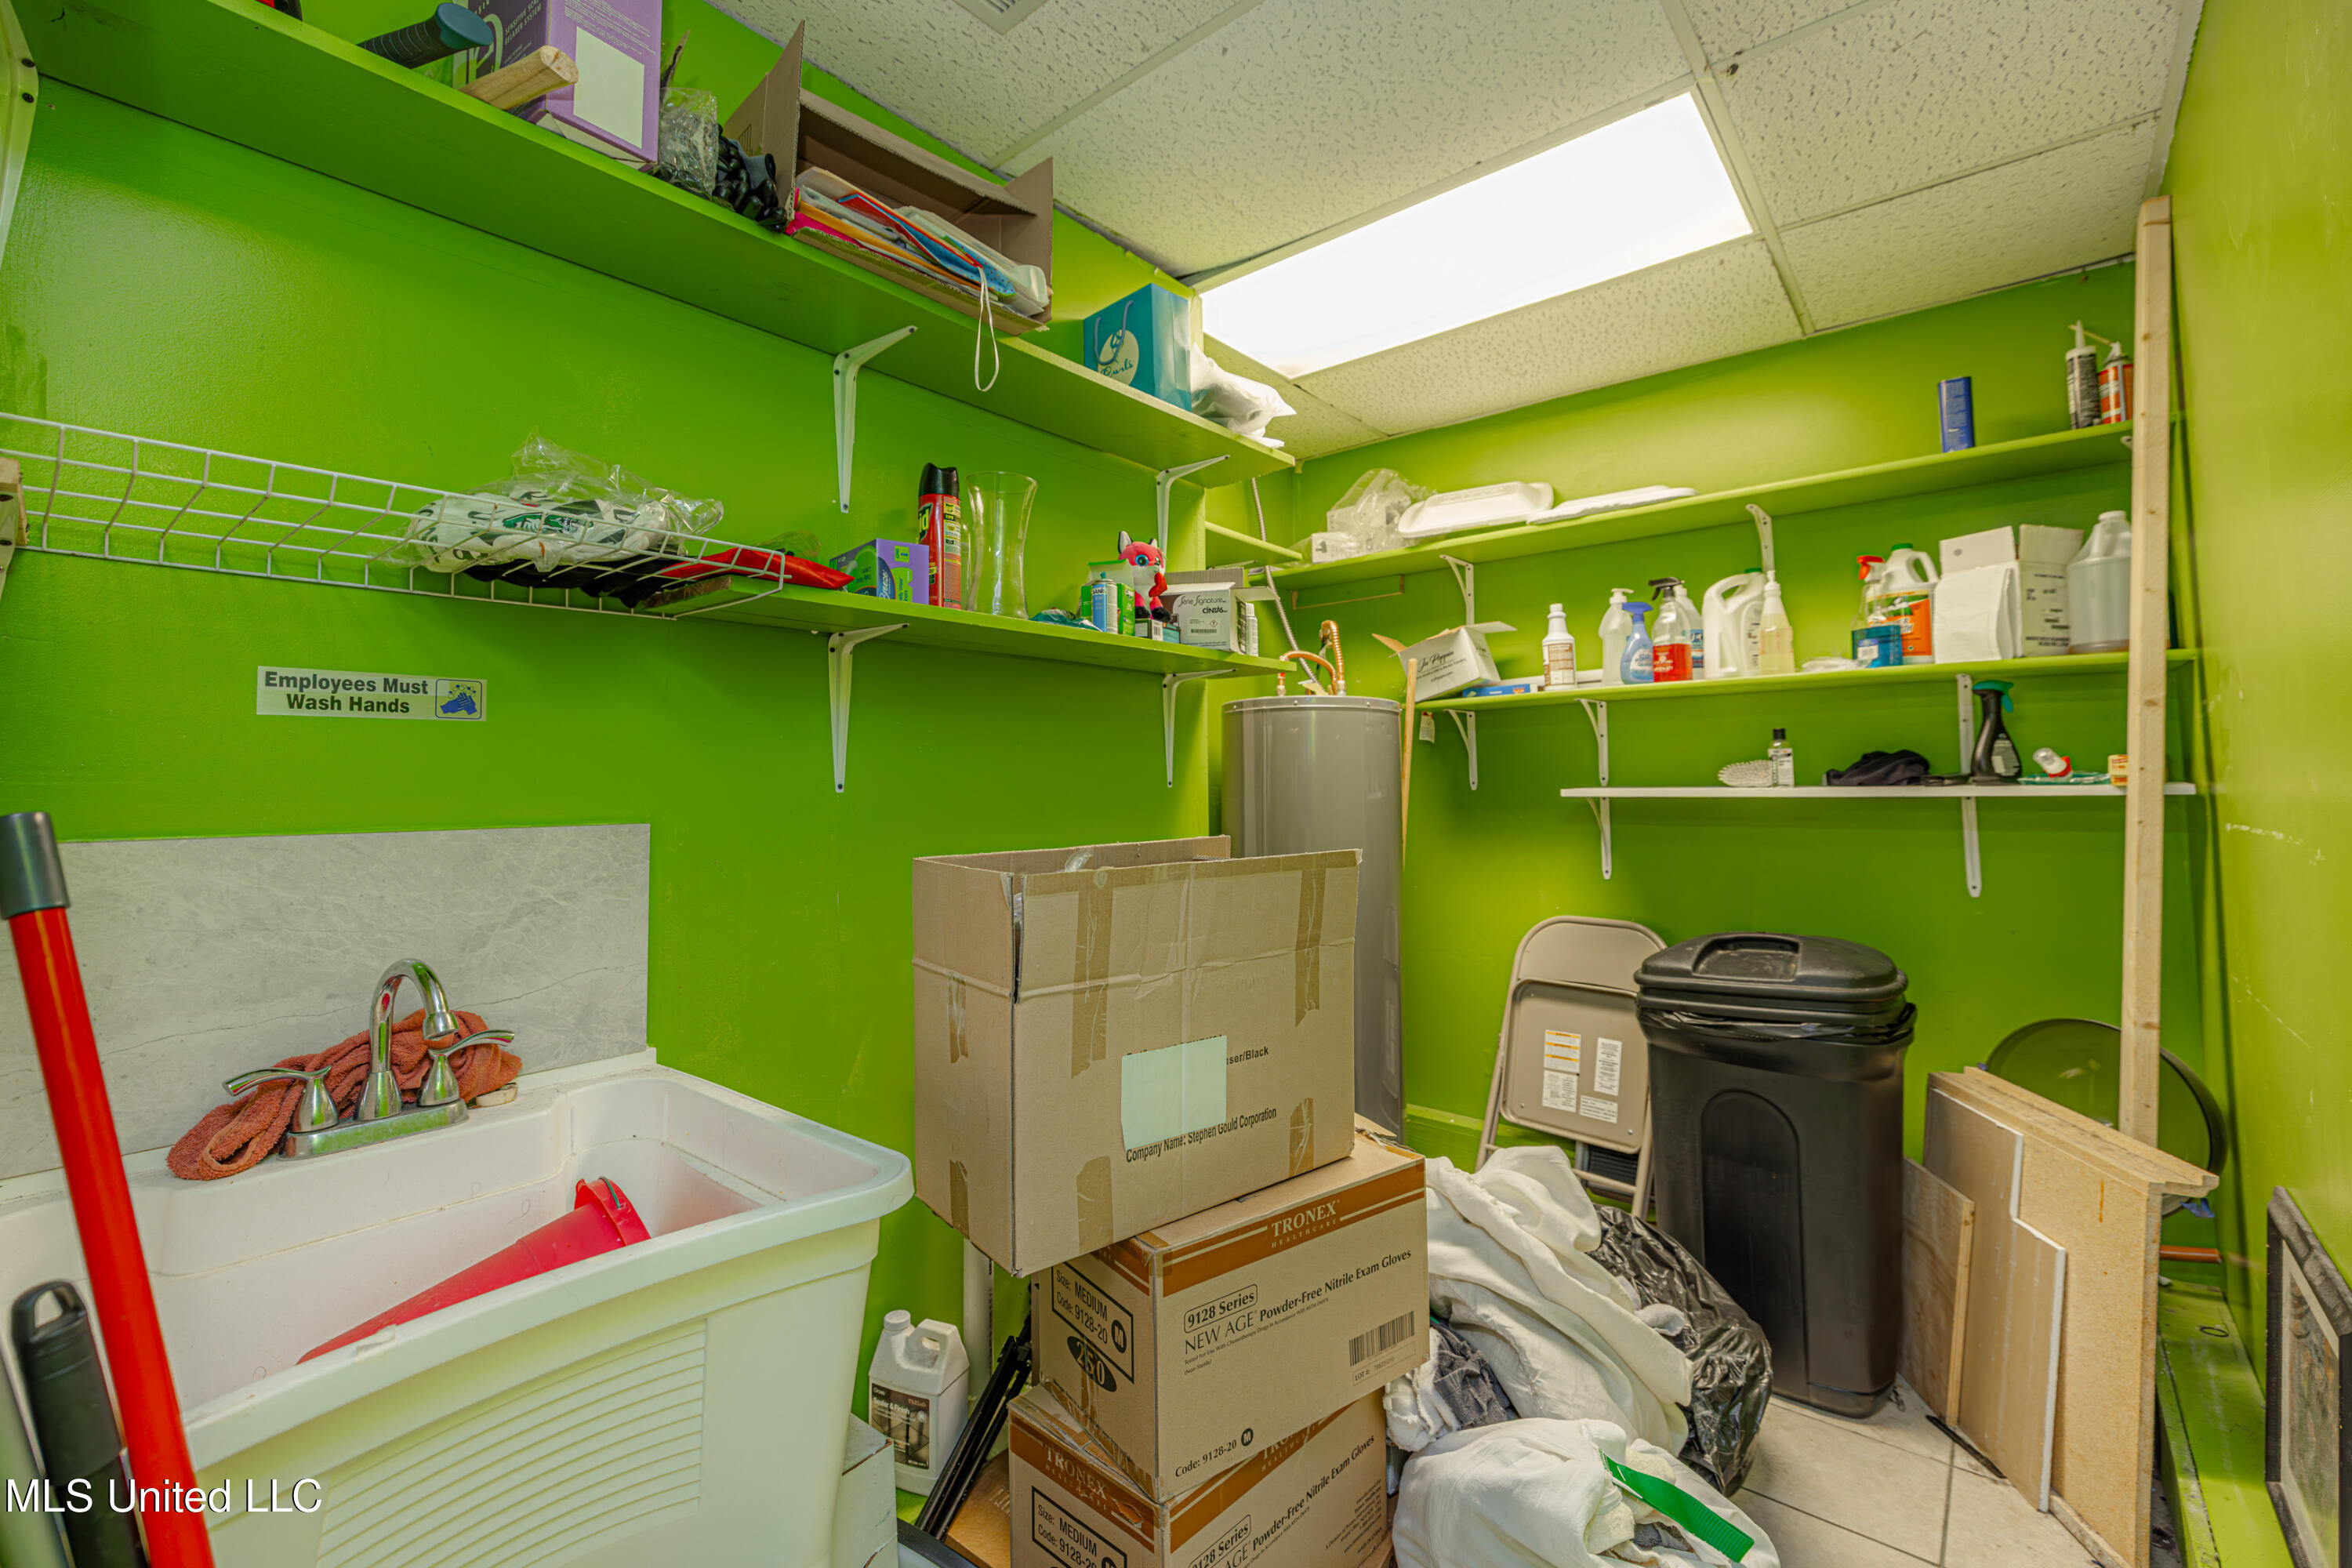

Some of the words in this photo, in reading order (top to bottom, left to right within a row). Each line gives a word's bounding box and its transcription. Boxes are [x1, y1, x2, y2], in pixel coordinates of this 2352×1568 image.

[265, 671, 377, 694] Employees
[383, 677, 428, 695] Must
[286, 694, 343, 711] Wash
[349, 696, 410, 713] Hands
[1126, 1143, 1162, 1163] Company
[1163, 1136, 1186, 1152] Name:
[1188, 1126, 1216, 1144] Stephen
[1218, 1118, 1238, 1134] Gould
[1239, 1107, 1276, 1127] Corporation
[1271, 1200, 1337, 1238] TRONEX
[1271, 1218, 1337, 1249] HEALTHCARE
[1056, 1269, 1071, 1291] Size:
[1075, 1281, 1107, 1321] MEDIUM
[1185, 1325, 1221, 1355] NEW
[1225, 1311, 1254, 1338] AGE
[1260, 1287, 1323, 1322] Powder-Free
[1324, 1272, 1354, 1294] Nitrile
[1356, 1261, 1380, 1280] Exam
[1381, 1250, 1411, 1269] Gloves
[1188, 1305, 1216, 1328] 9128
[1218, 1292, 1254, 1315] Series
[1056, 1291, 1074, 1315] Code:
[1075, 1305, 1108, 1345] 9128-20
[1114, 1325, 1124, 1348] M
[1076, 1341, 1106, 1385] 250
[1045, 1444, 1107, 1501] TRONEX
[1175, 1458, 1201, 1477] Code:
[1202, 1439, 1237, 1465] 9128-20
[1253, 1498, 1305, 1552] Powder-Free
[1305, 1475, 1330, 1504] Nitrile
[1330, 1457, 1350, 1480] Exam
[1351, 1435, 1374, 1461] Gloves
[1038, 1504, 1054, 1525] Size:
[1059, 1517, 1097, 1558] MEDIUM
[1038, 1524, 1058, 1548] Code:
[1218, 1523, 1249, 1557] Series
